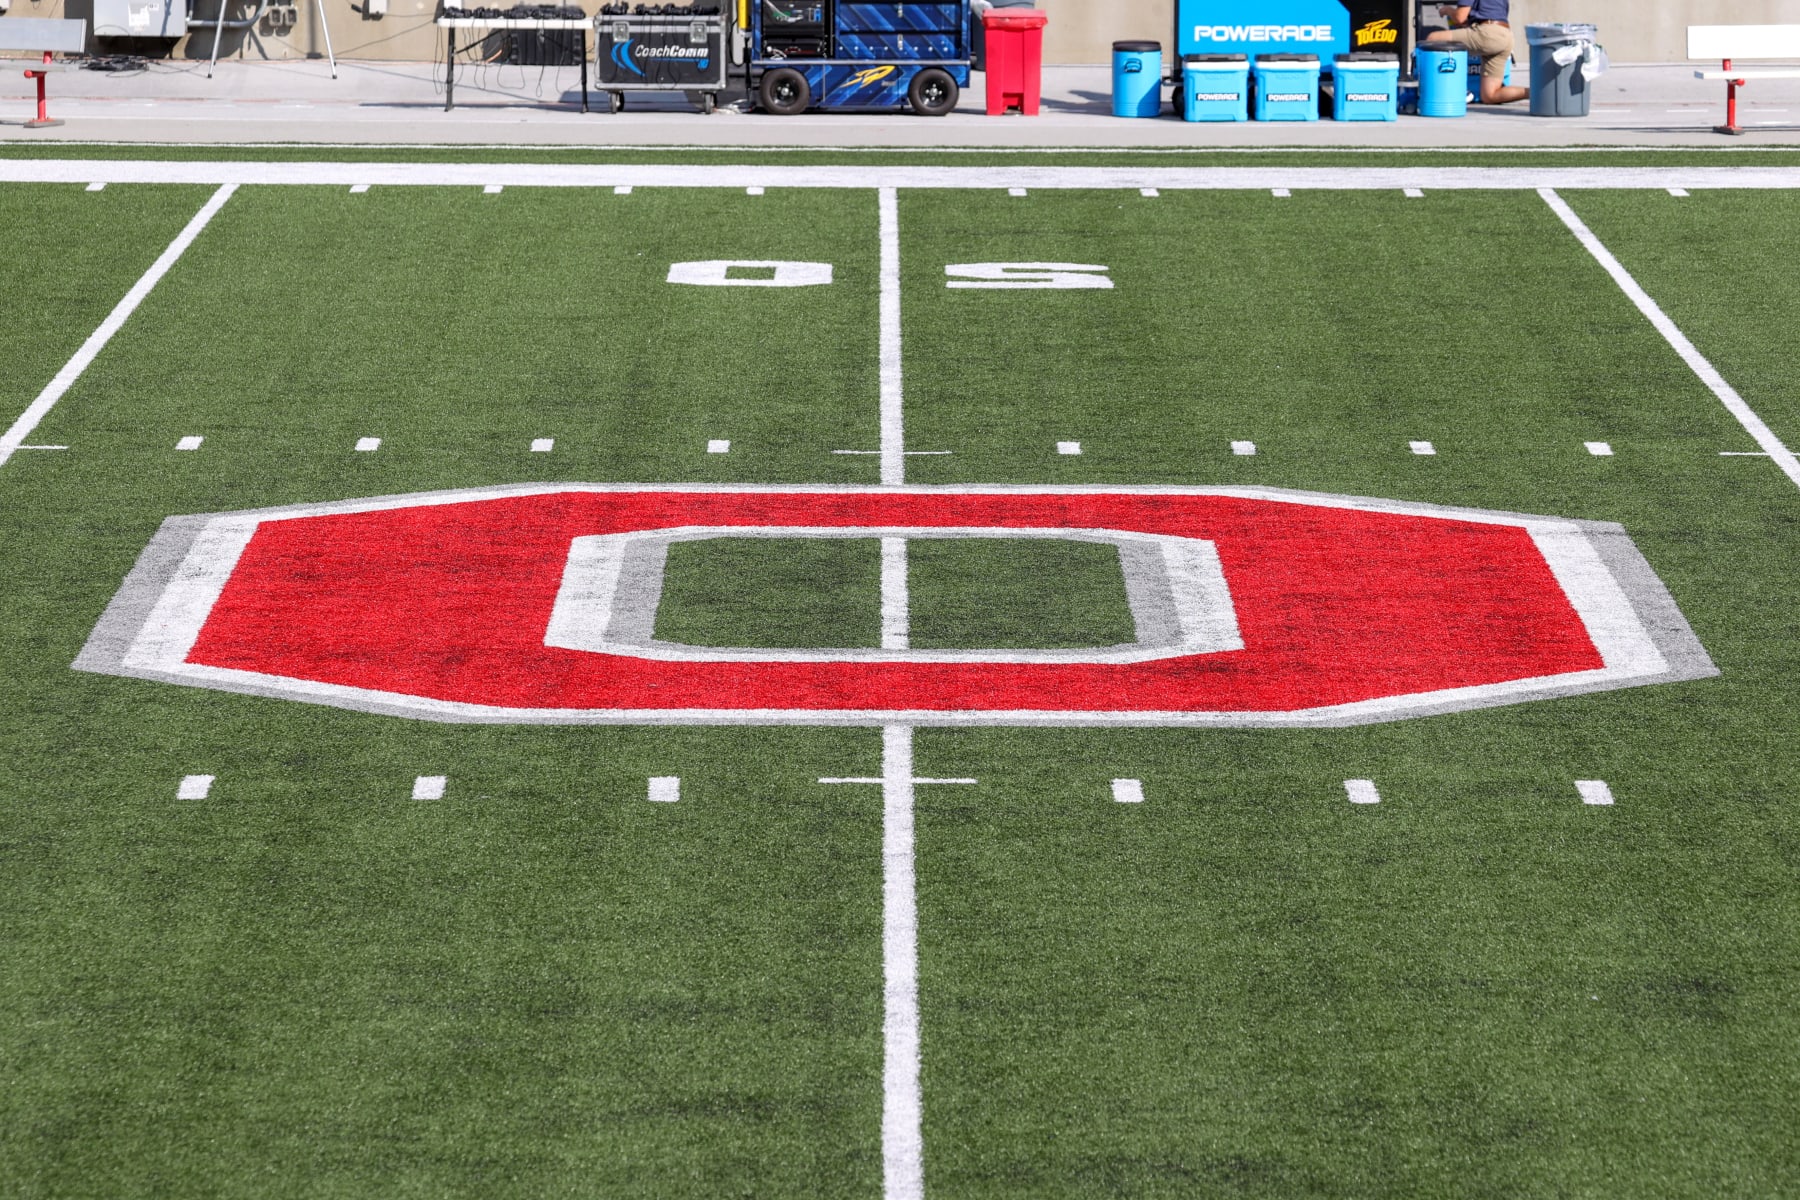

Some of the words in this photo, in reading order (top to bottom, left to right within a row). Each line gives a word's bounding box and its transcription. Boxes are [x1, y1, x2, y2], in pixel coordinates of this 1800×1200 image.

[1194, 25, 1332, 42] POWERADE
[1355, 28, 1397, 46] TOLEDO
[635, 44, 709, 58] CoachComm
[1197, 93, 1238, 101] POWERADE
[1267, 94, 1309, 102] POWERADE
[1347, 94, 1388, 102] POWERADE
